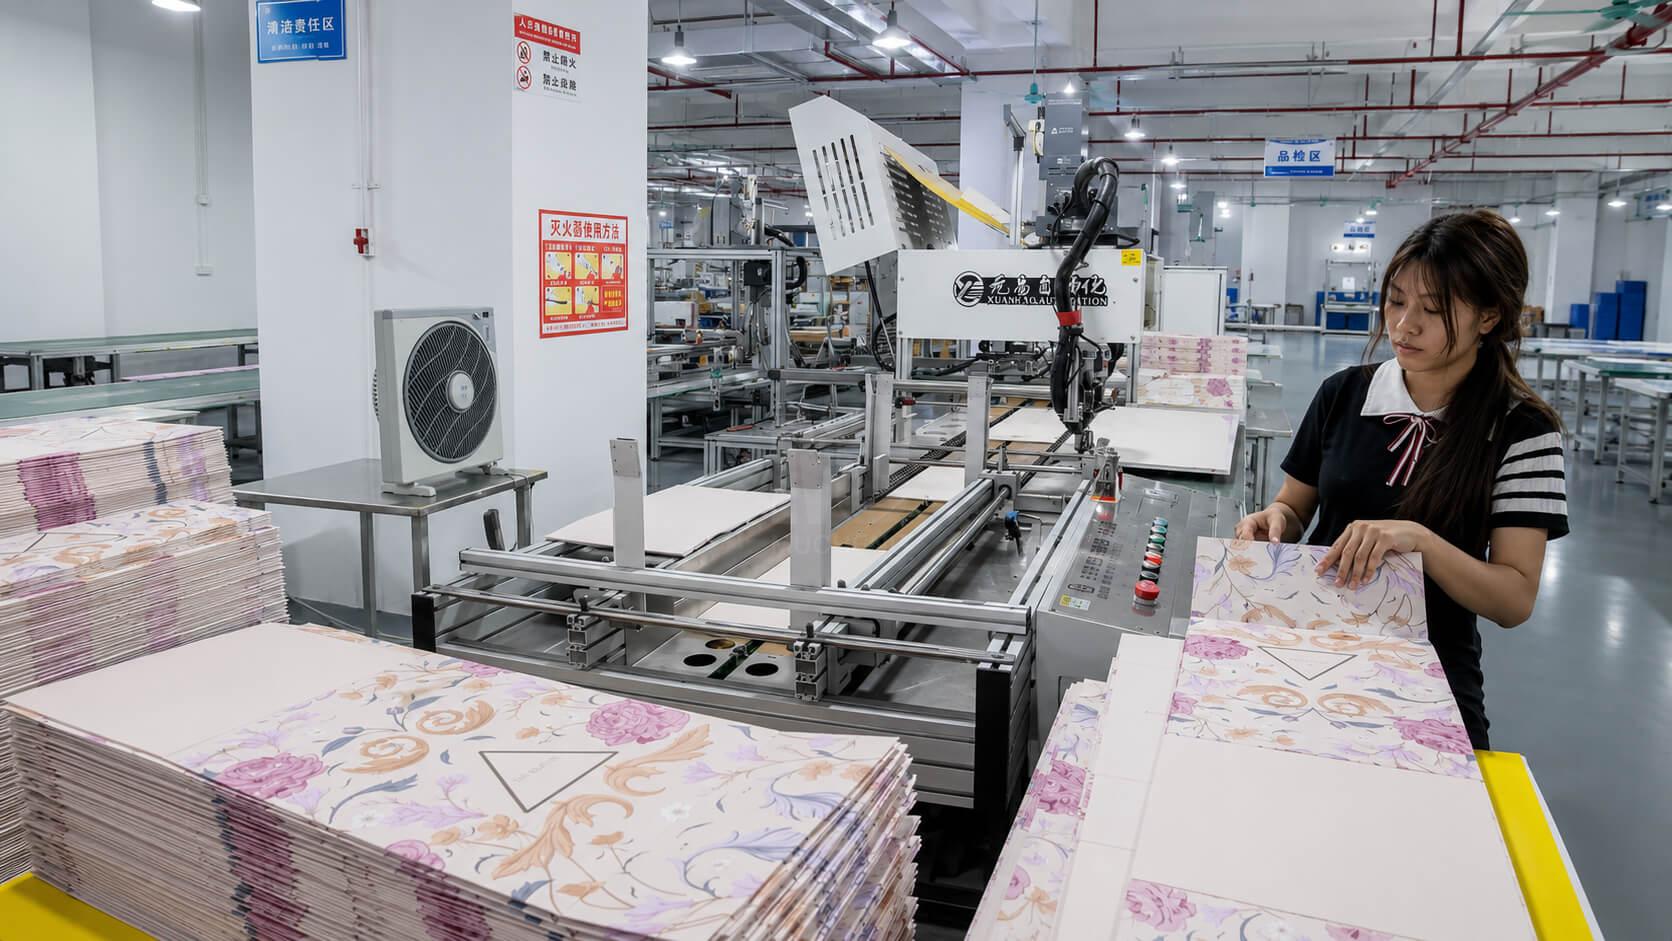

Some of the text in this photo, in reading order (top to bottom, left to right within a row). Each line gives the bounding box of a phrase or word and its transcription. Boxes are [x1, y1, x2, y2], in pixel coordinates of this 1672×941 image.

[550, 219, 620, 240] 灭火器使用方法
